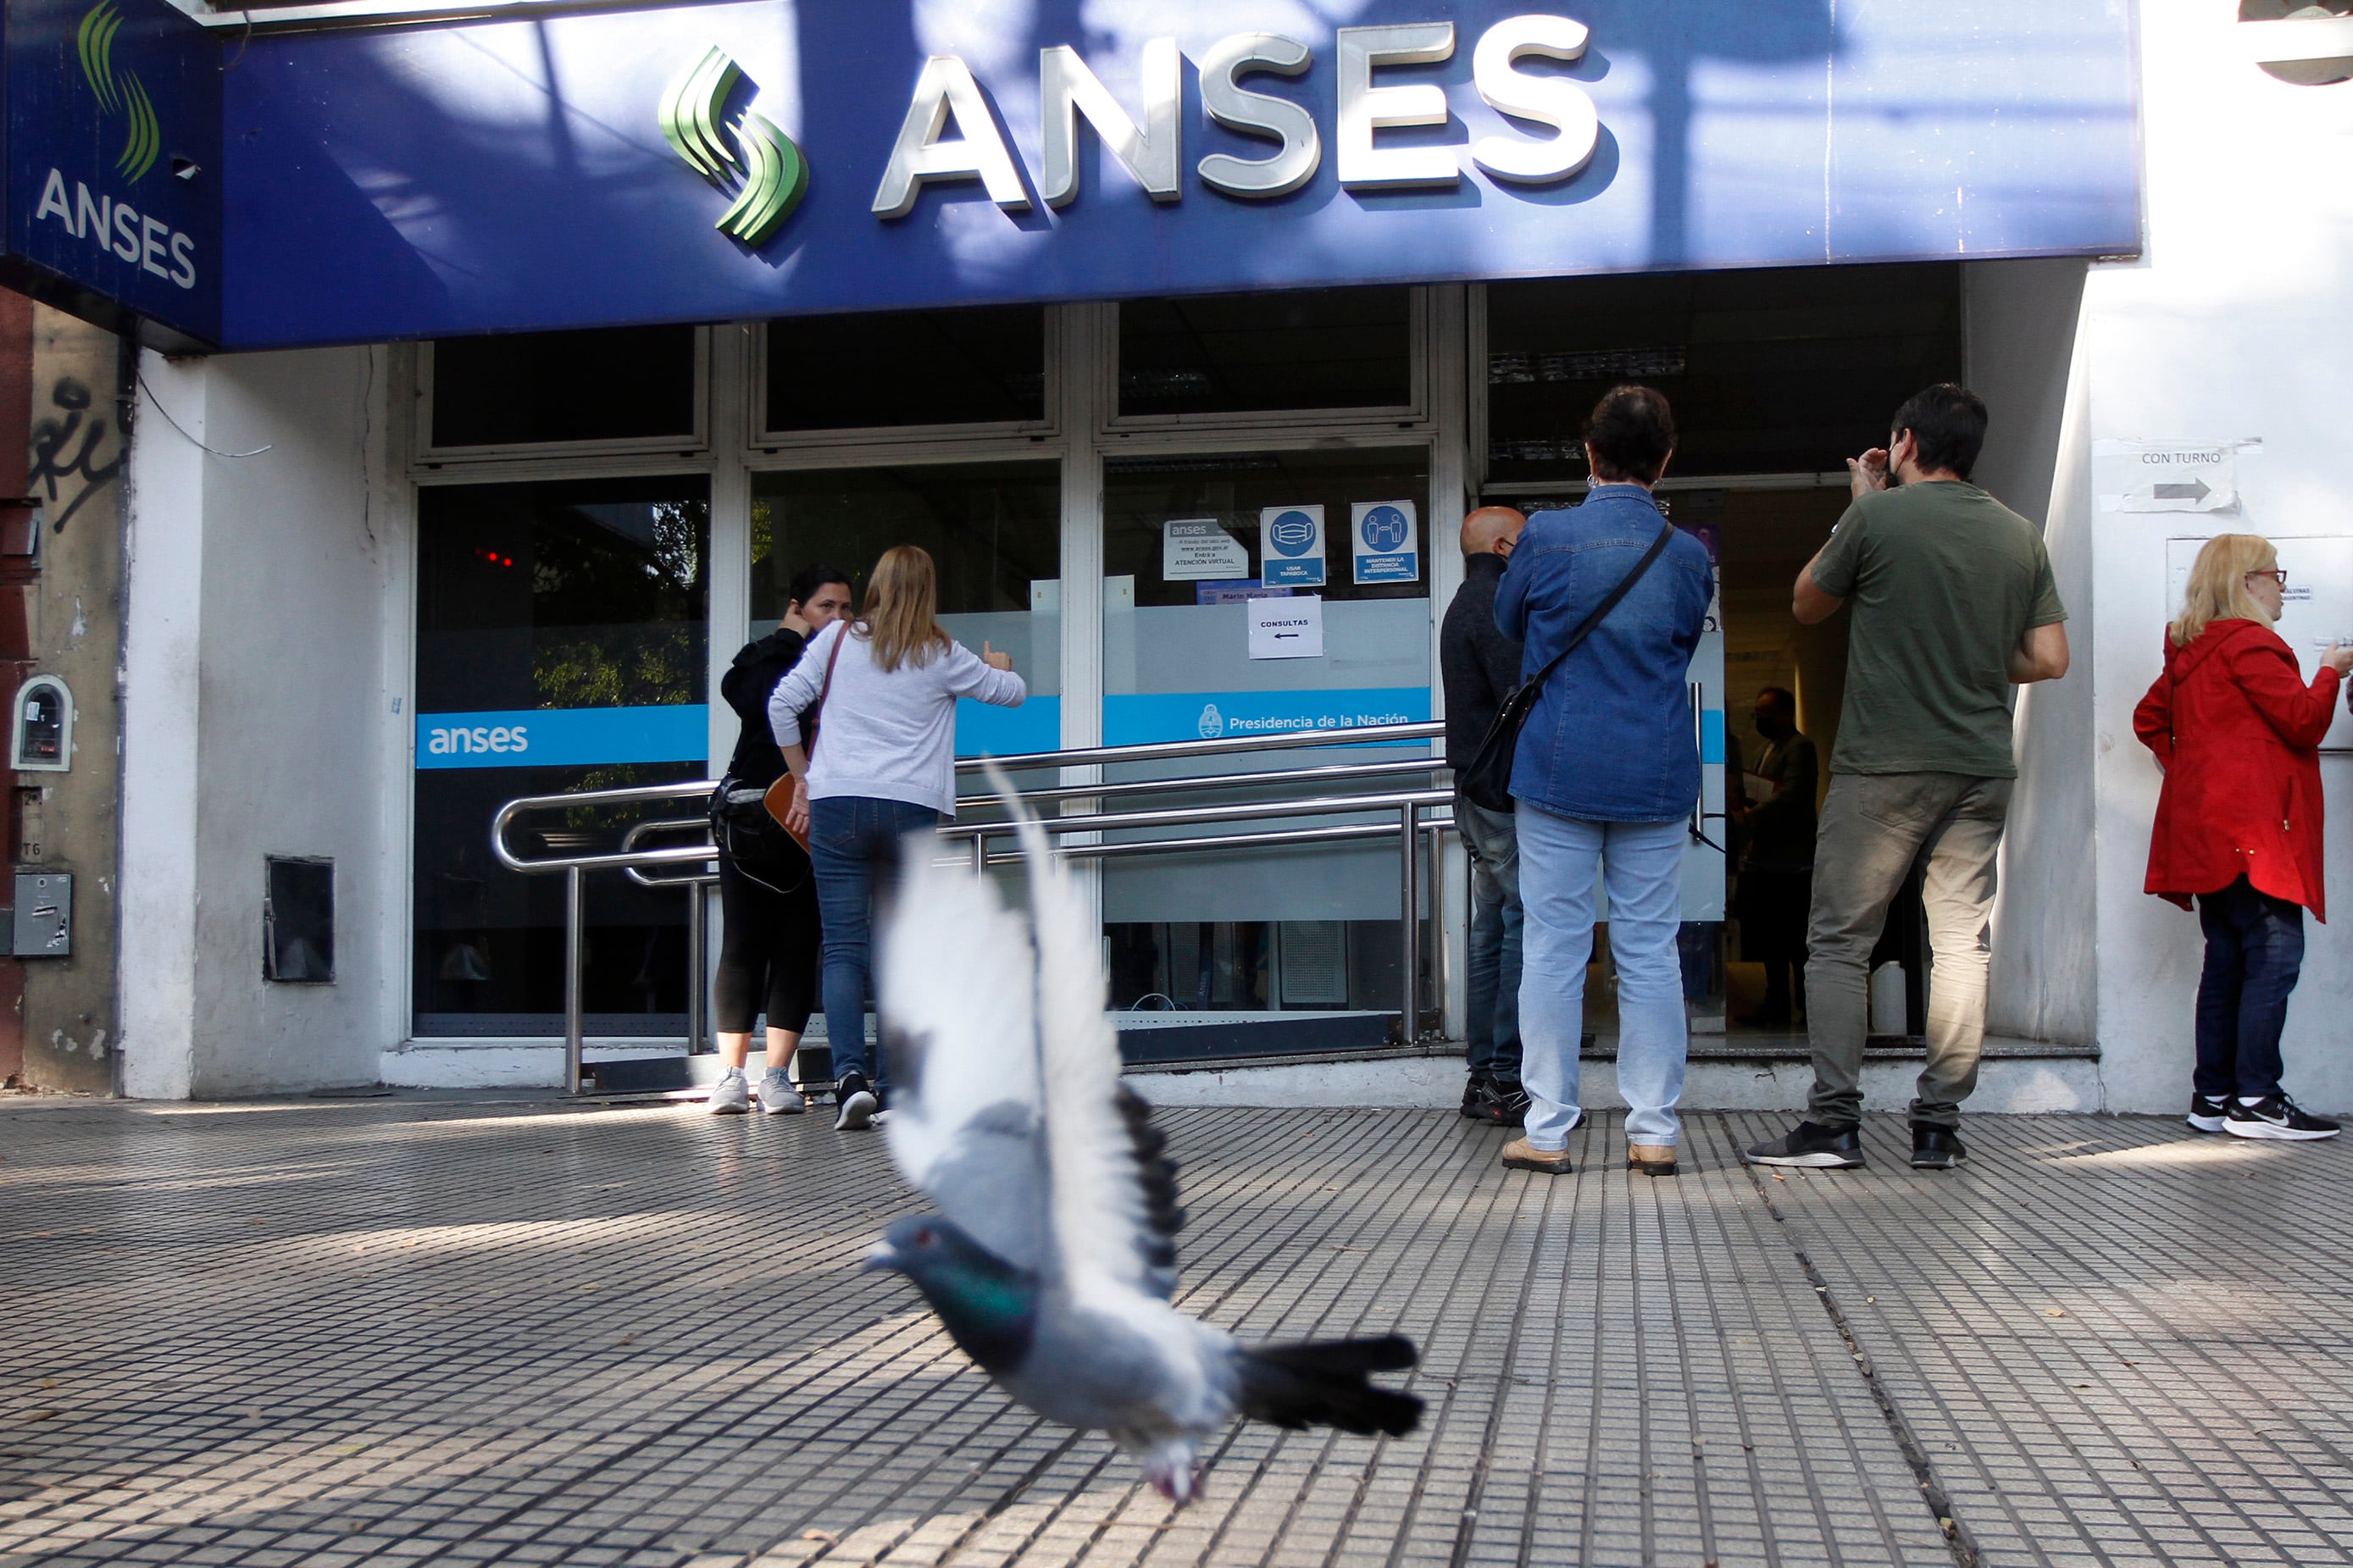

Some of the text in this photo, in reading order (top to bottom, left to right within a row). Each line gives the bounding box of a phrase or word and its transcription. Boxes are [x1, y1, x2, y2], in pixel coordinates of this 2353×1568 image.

[871, 14, 1599, 221] ANSES
[36, 168, 196, 289] ANSES
[2142, 452, 2221, 463] CON TURNO
[1172, 525, 1207, 535] anses
[1261, 619, 1308, 628] CONSULTAS
[1229, 713, 1408, 729] Presidencia de la Nación
[429, 726, 529, 754] anses
